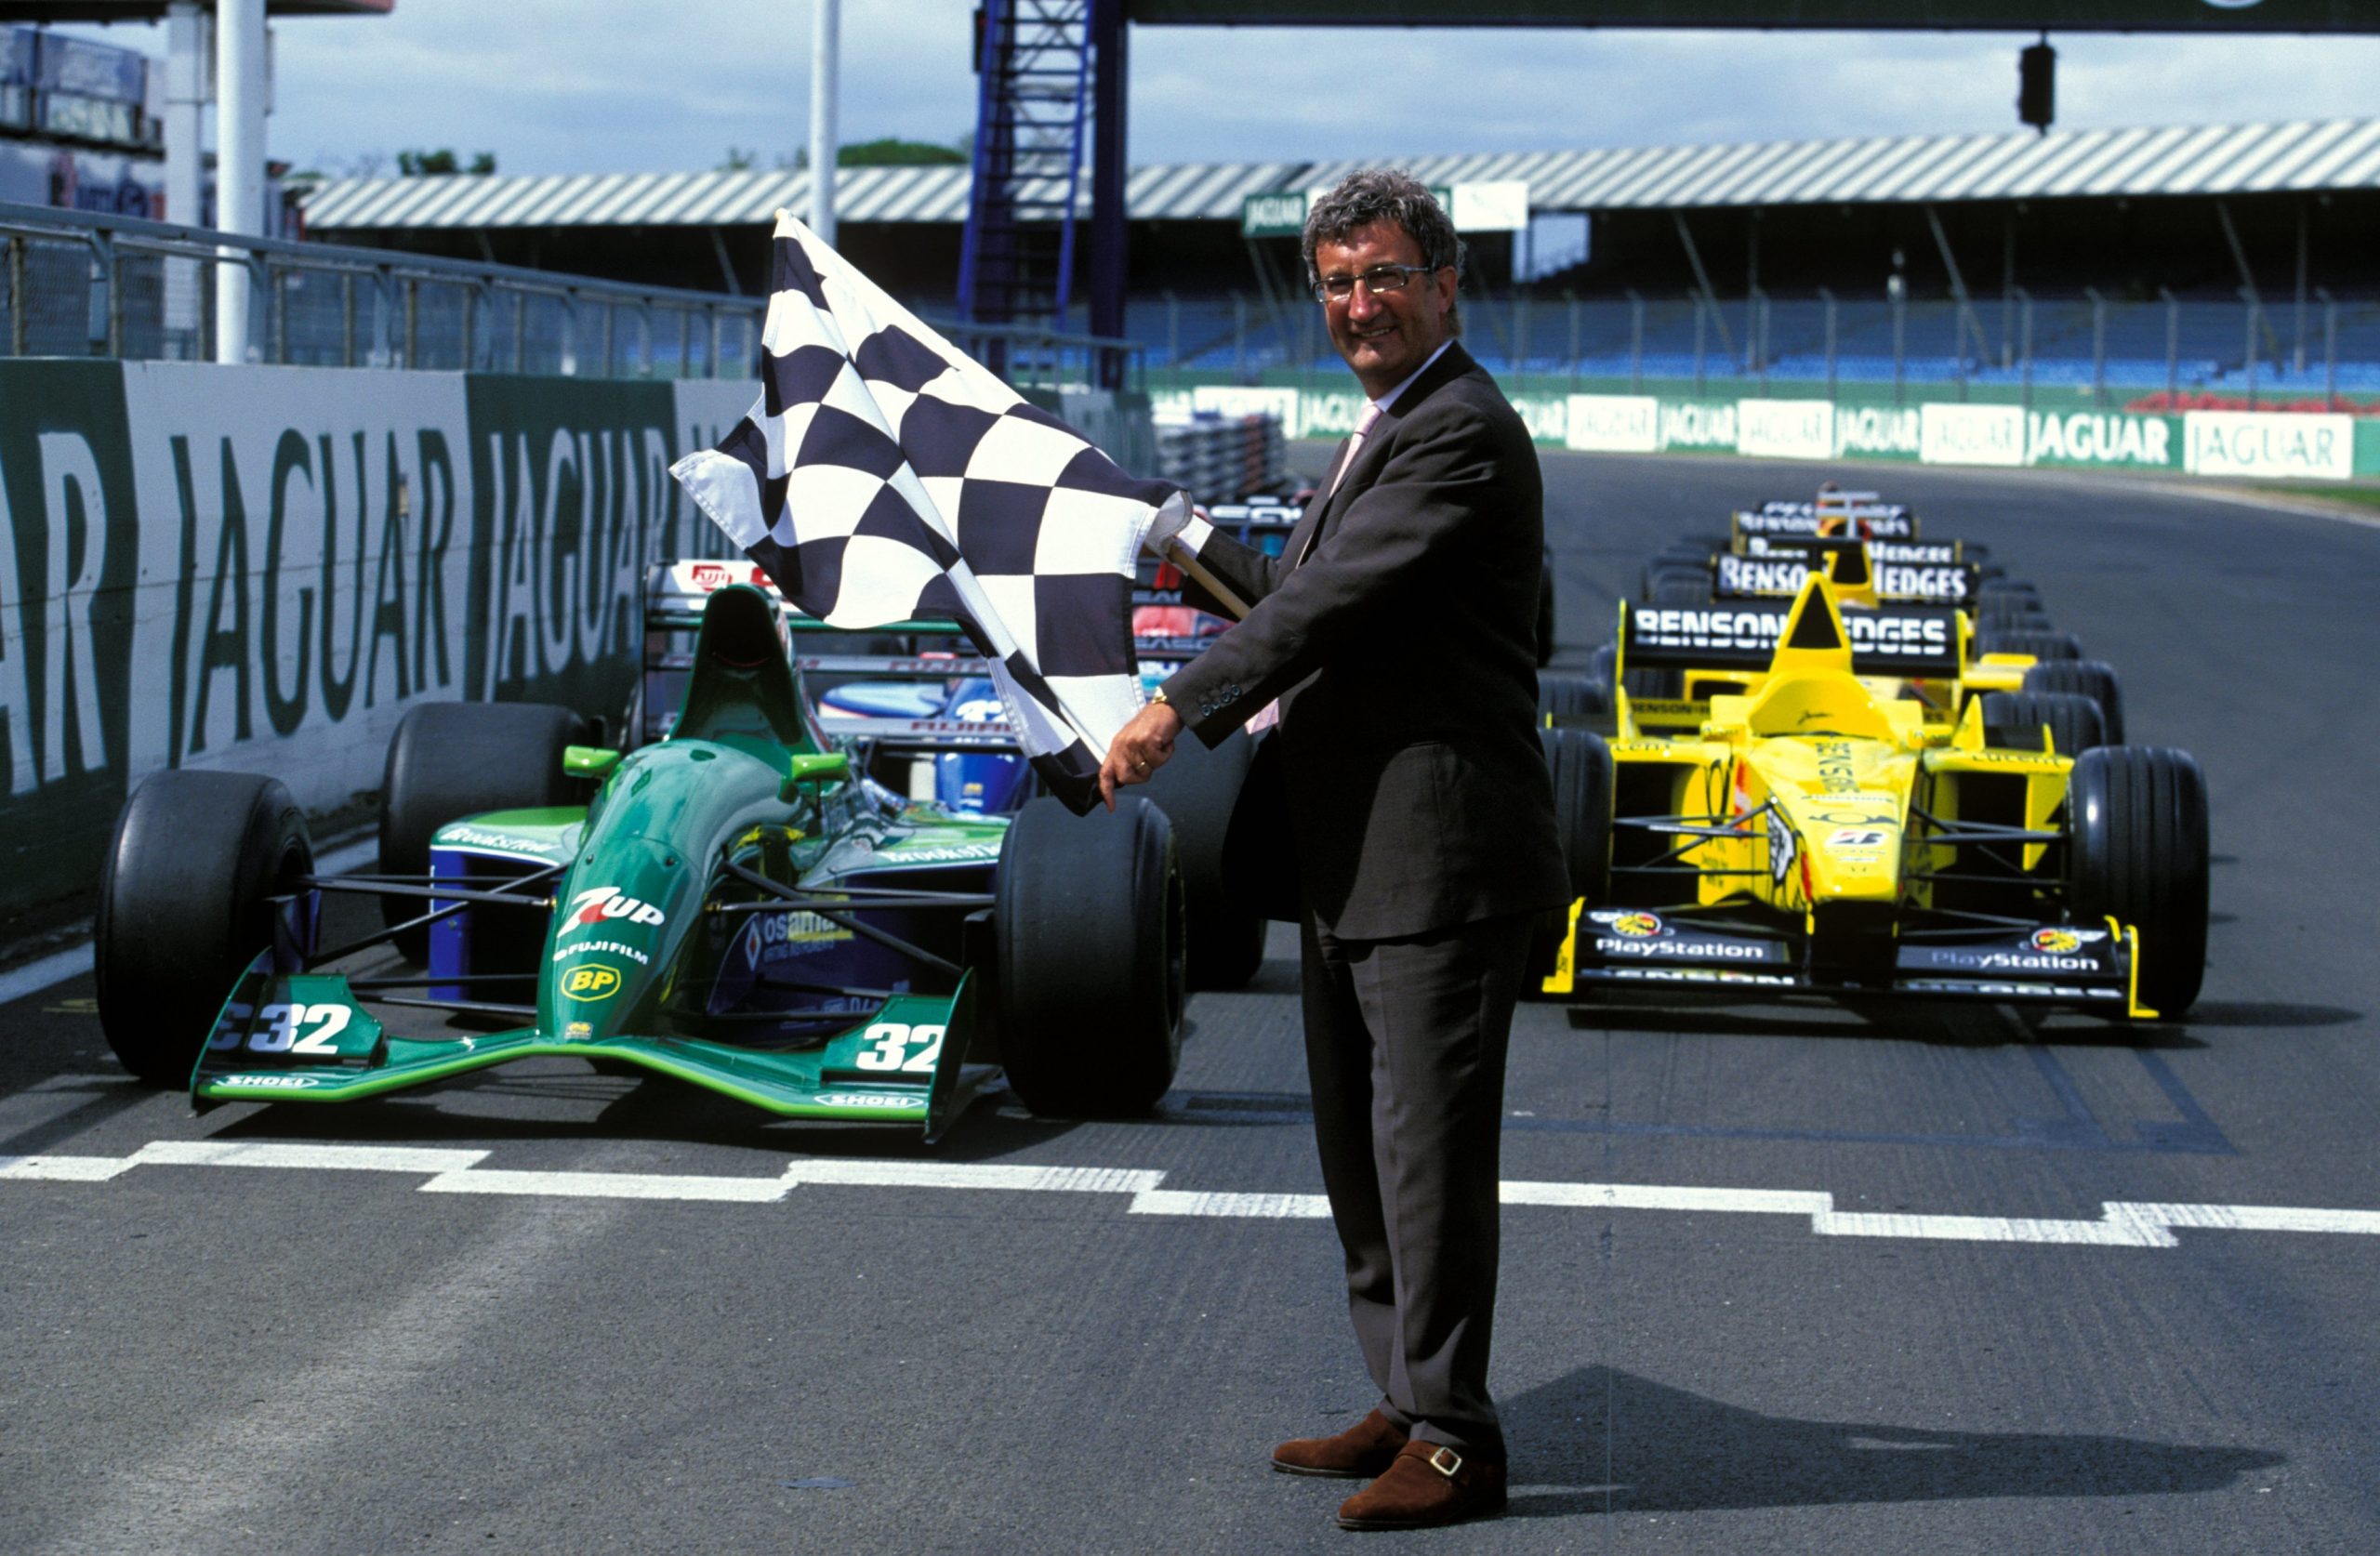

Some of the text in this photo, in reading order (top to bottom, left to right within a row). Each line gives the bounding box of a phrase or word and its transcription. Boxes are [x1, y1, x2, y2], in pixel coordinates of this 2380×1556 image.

[2027, 411, 2170, 466] JAGUAR
[2193, 424, 2334, 467] JAGUAR
[482, 427, 671, 704] JAGUAR
[1720, 556, 1808, 592] BENSO
[169, 428, 455, 770] JAGUAR
[1635, 609, 1947, 655] BENSON DGES
[567, 941, 649, 965] FUJIFILM
[1595, 938, 1764, 958] PlayStation
[1931, 951, 2099, 970] PlayStation
[569, 970, 615, 991] BP
[247, 1003, 352, 1054] 32
[855, 1022, 946, 1073] 32
[226, 1075, 305, 1088] SHOEI
[830, 1095, 909, 1107] SHOEI
